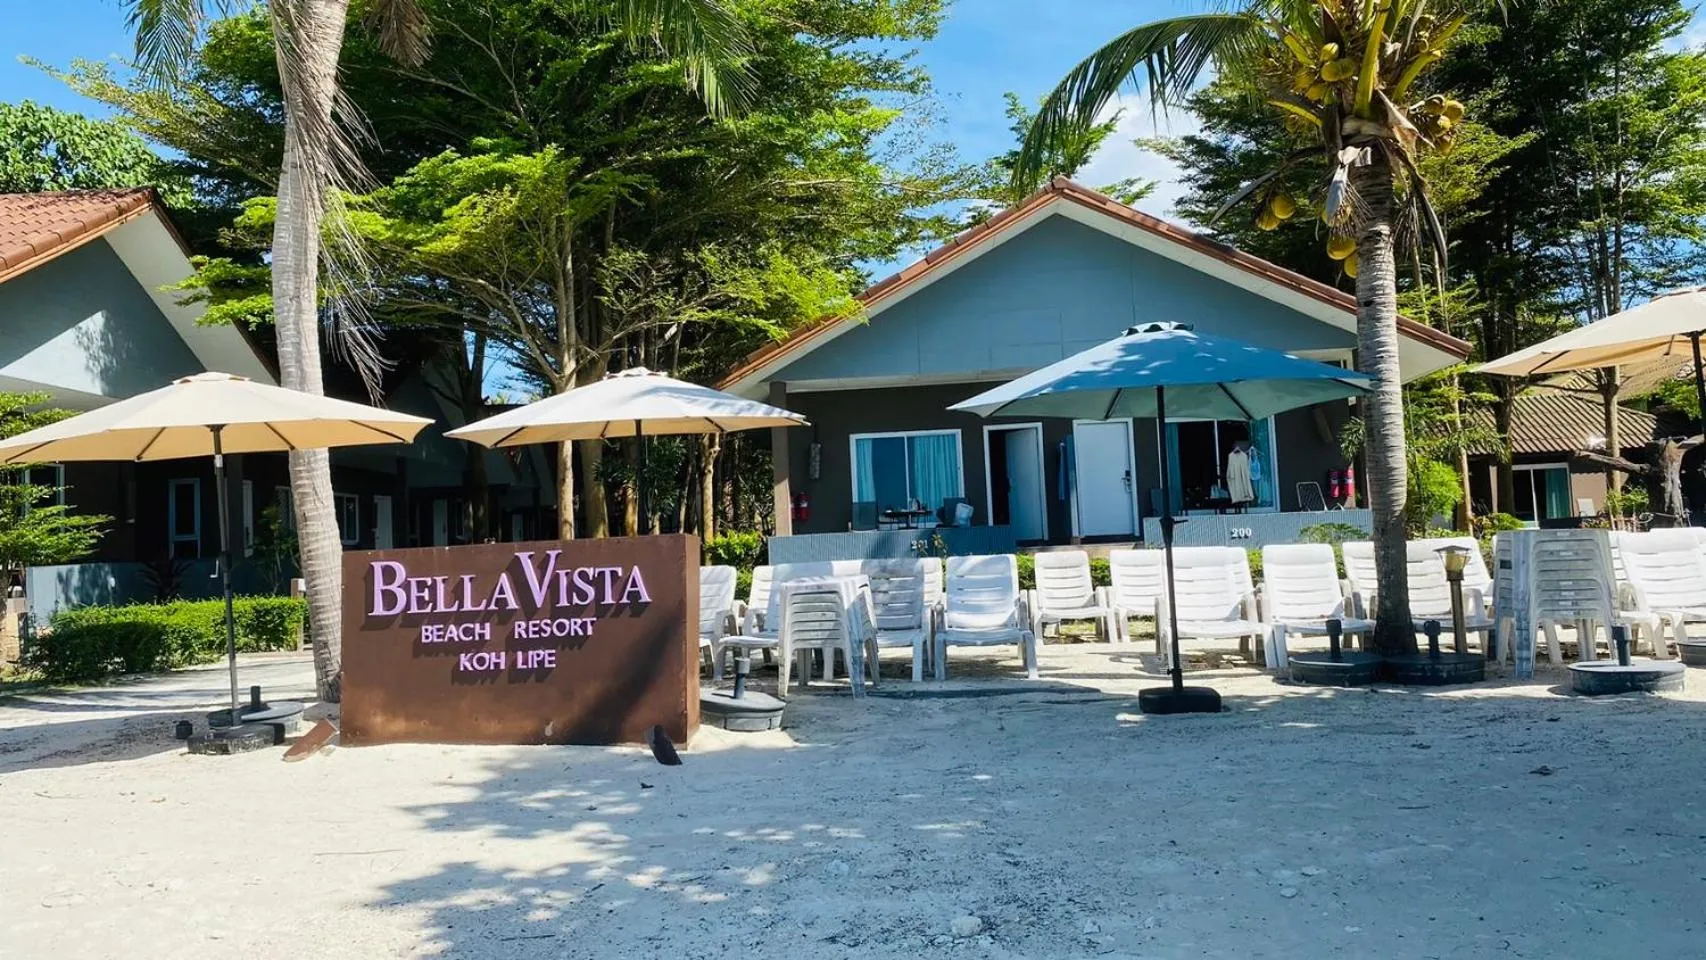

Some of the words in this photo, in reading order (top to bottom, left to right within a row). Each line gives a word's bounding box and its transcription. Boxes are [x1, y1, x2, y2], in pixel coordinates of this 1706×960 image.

[1231, 528, 1252, 537] 200
[421, 622, 491, 644] BEACH
[514, 617, 597, 639] RESORT
[459, 652, 506, 672] KOH
[516, 650, 556, 669] LIPE
